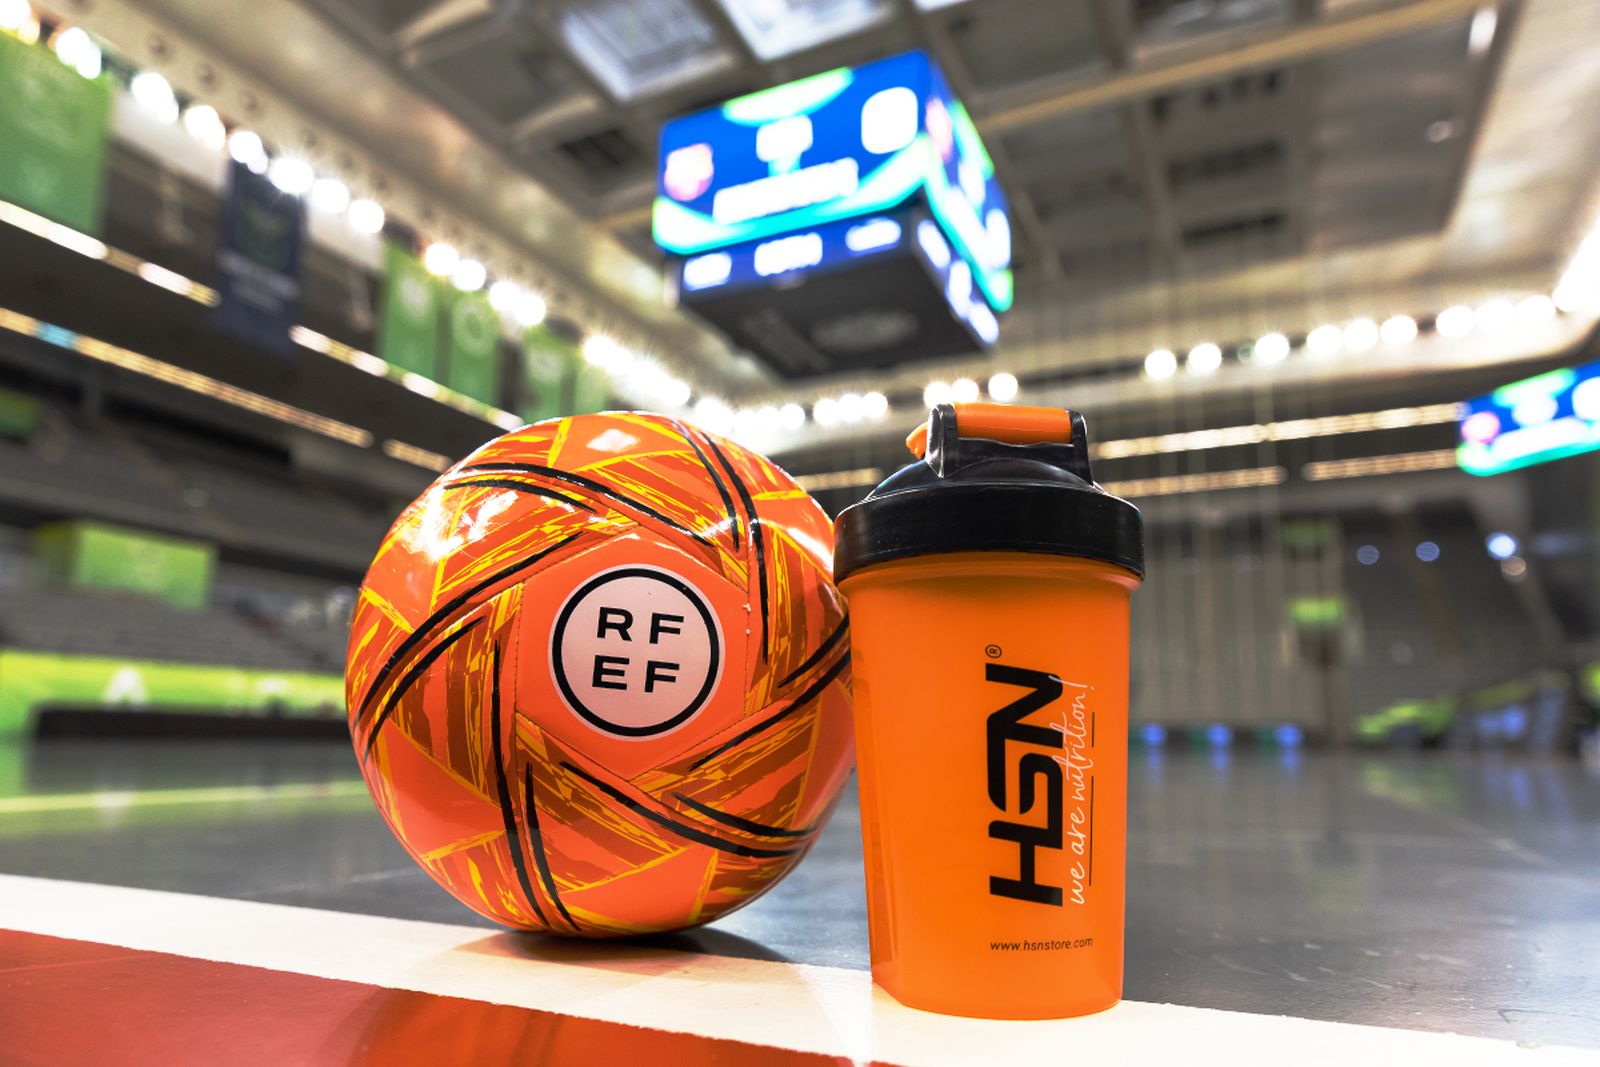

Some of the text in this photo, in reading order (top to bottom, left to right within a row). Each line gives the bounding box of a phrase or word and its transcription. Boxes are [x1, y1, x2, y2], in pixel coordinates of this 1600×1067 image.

[1048, 675, 1095, 905] we are nutrition!
[989, 937, 1094, 951] www.hsnstore.com
